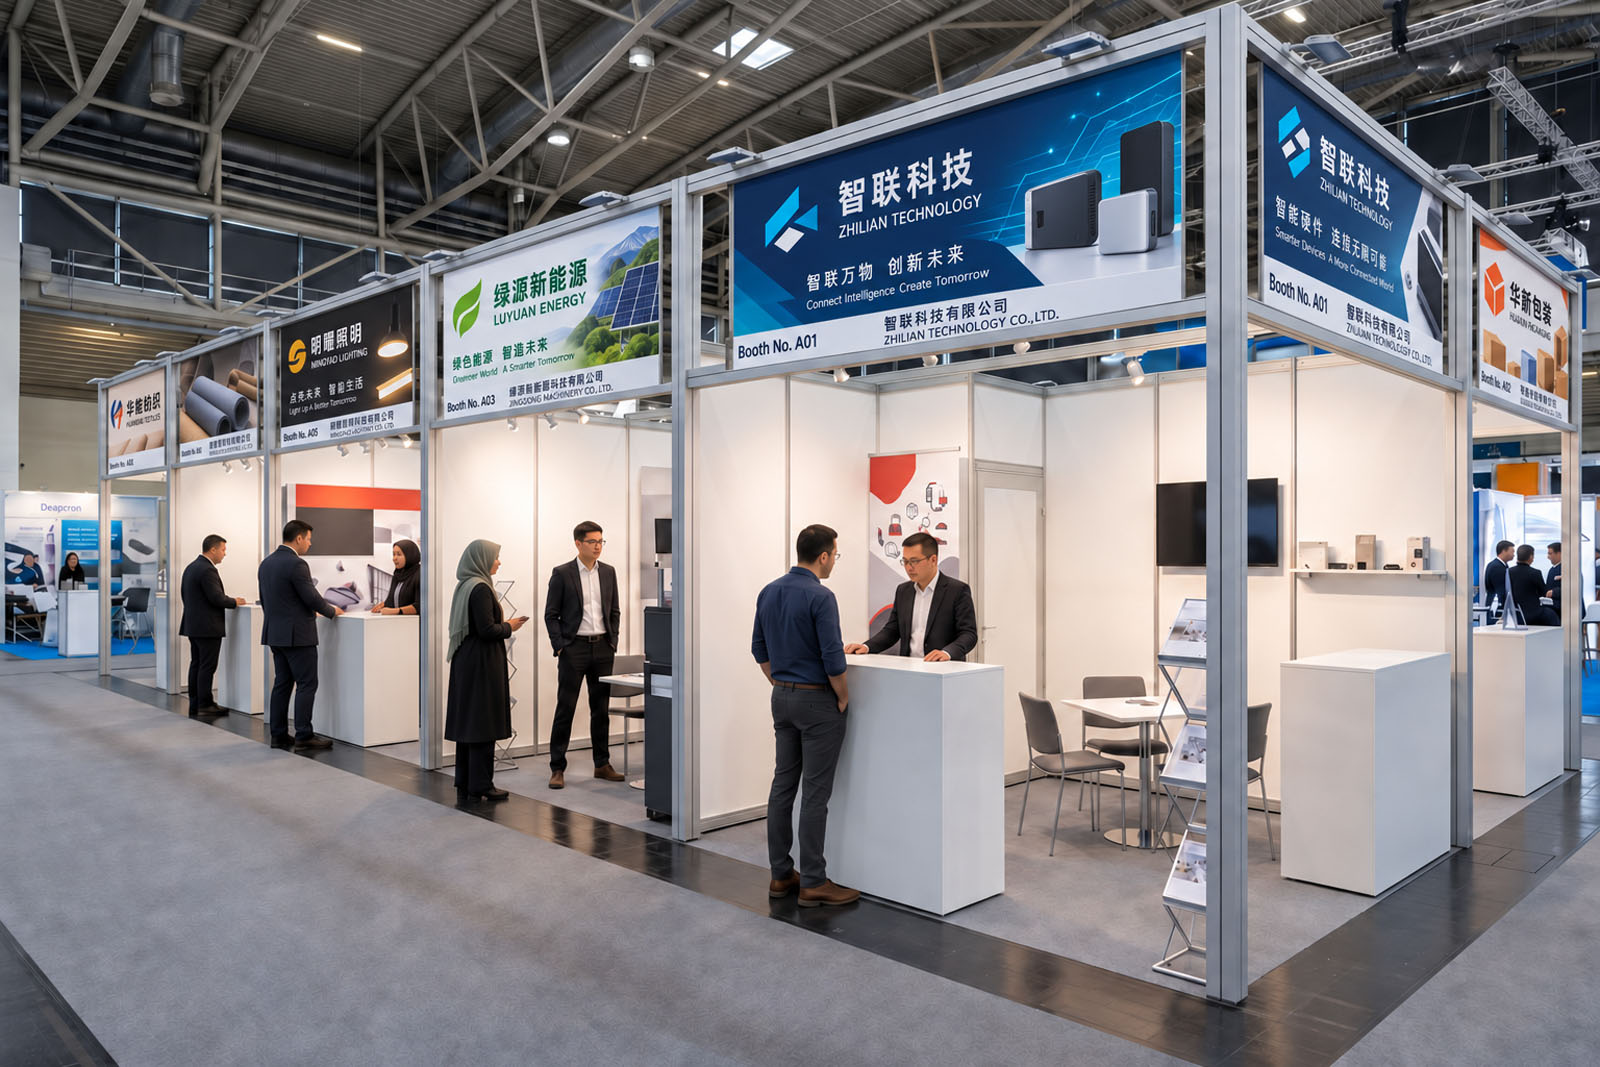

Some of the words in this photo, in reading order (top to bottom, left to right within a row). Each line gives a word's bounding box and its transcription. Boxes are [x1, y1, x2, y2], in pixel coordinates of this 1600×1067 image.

[838, 147, 973, 217] 智联科技
[1320, 135, 1391, 213] 智联科技
[838, 215, 888, 239] ZHILIAN
[891, 193, 982, 226] TECHNOLOGY
[1275, 195, 1323, 239] 智能硬件
[1320, 176, 1349, 205] ZHILIAN
[1349, 194, 1394, 232] TECHNOLOGY
[1275, 226, 1300, 247] Smarter
[1301, 239, 1326, 261] Devices
[493, 258, 588, 309] 绿源新能源
[806, 262, 873, 293] 智联万物
[888, 244, 964, 276] 创新未来
[806, 294, 842, 311] Connect
[844, 285, 895, 304] Intelligence
[899, 278, 932, 294] Create
[935, 268, 990, 287] Tomorrow
[1269, 272, 1295, 301] Booth
[1297, 284, 1312, 307] No.
[1313, 292, 1328, 314] A01
[493, 305, 536, 326] LUYUAN
[540, 292, 586, 315] ENERGY
[884, 298, 1008, 332] 智联科技有限公司
[884, 329, 925, 346] ZHILIAN
[928, 318, 1007, 341] TECHNOLOGY
[1009, 309, 1060, 328] CO.,LTD.
[338, 348, 368, 362] LIGHTING
[452, 349, 493, 371] 绿色能源
[502, 337, 548, 361] 智造未来
[509, 360, 536, 373] Smarter
[537, 352, 576, 366] Tomorrow
[738, 340, 770, 359] Booth
[772, 336, 793, 353] No.
[794, 333, 818, 351] A01
[447, 399, 466, 413] Booth
[467, 398, 480, 409] No.
[481, 394, 495, 407] A03
[283, 432, 297, 442] Booth
[40, 503, 82, 513] Deapcron
